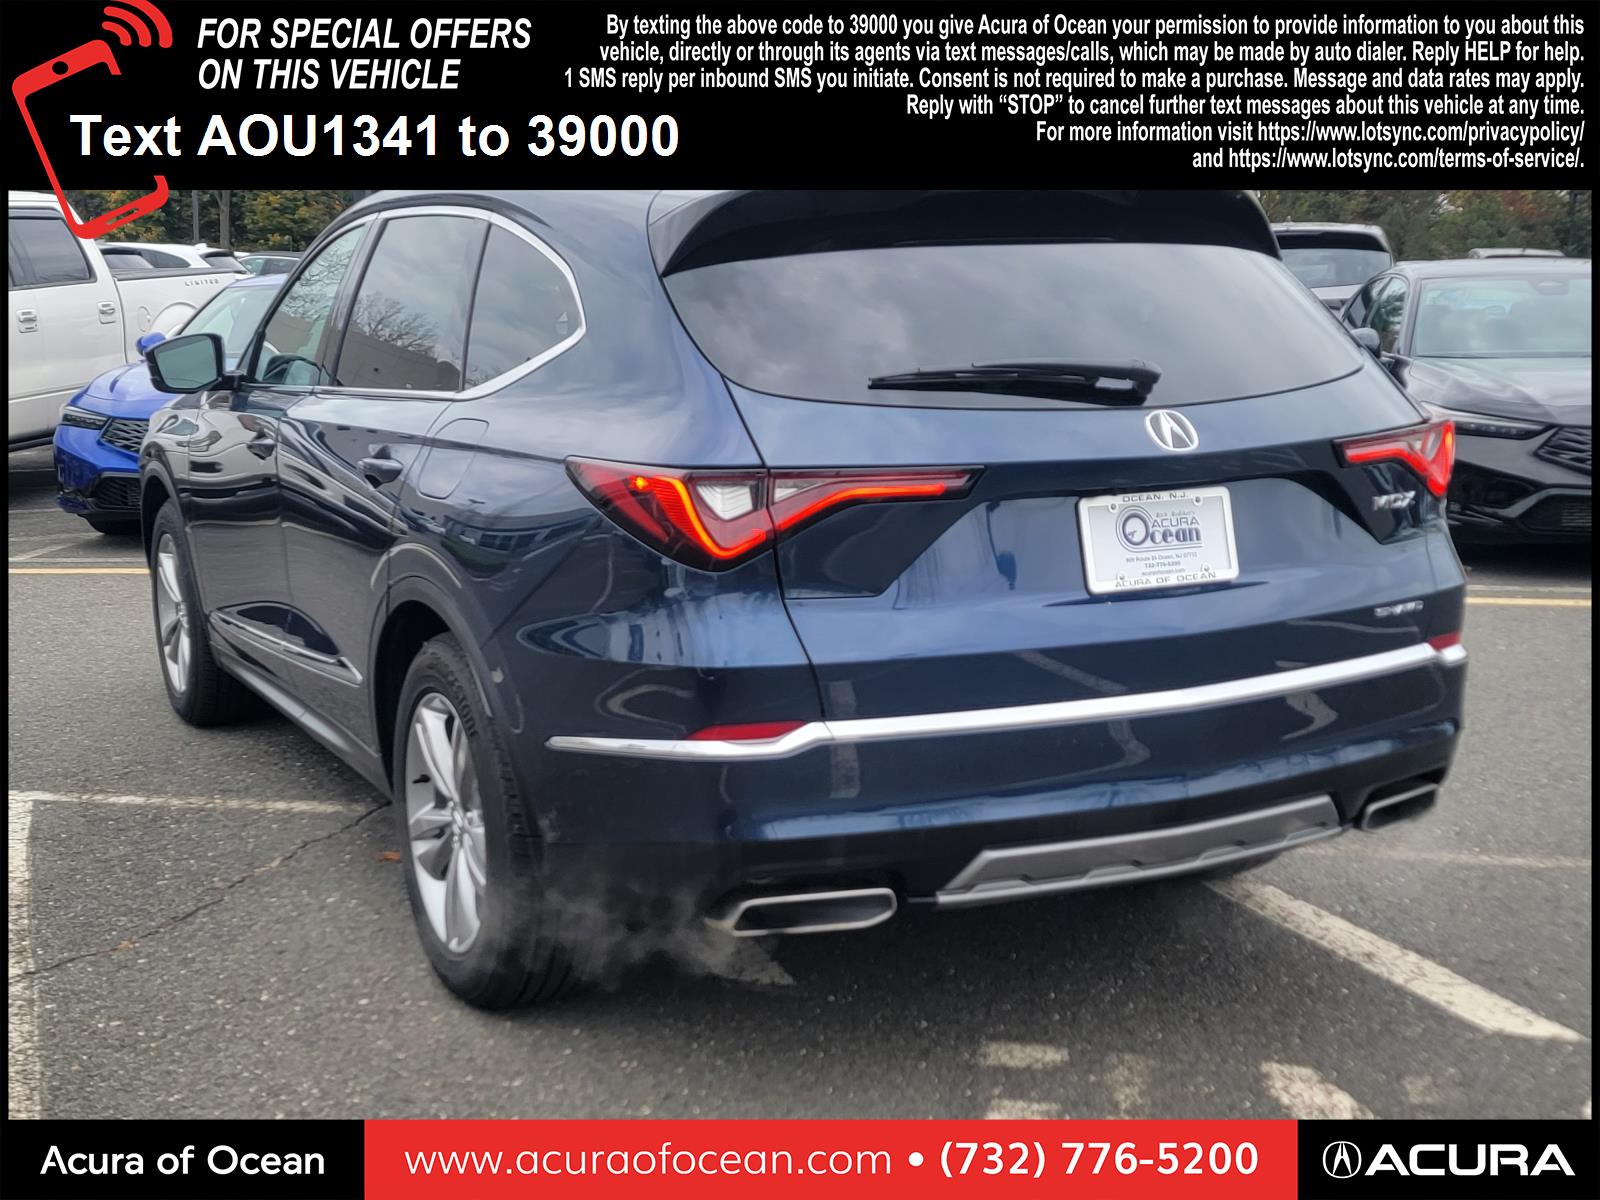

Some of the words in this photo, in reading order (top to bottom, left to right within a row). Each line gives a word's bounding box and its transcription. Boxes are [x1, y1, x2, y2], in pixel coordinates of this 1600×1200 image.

[1121, 512, 1202, 546] Ocean
[1151, 516, 1200, 529] ACURA
[1115, 578, 1152, 588] ACURA
[1156, 576, 1171, 584] OF
[1176, 571, 1217, 583] OCEAN
